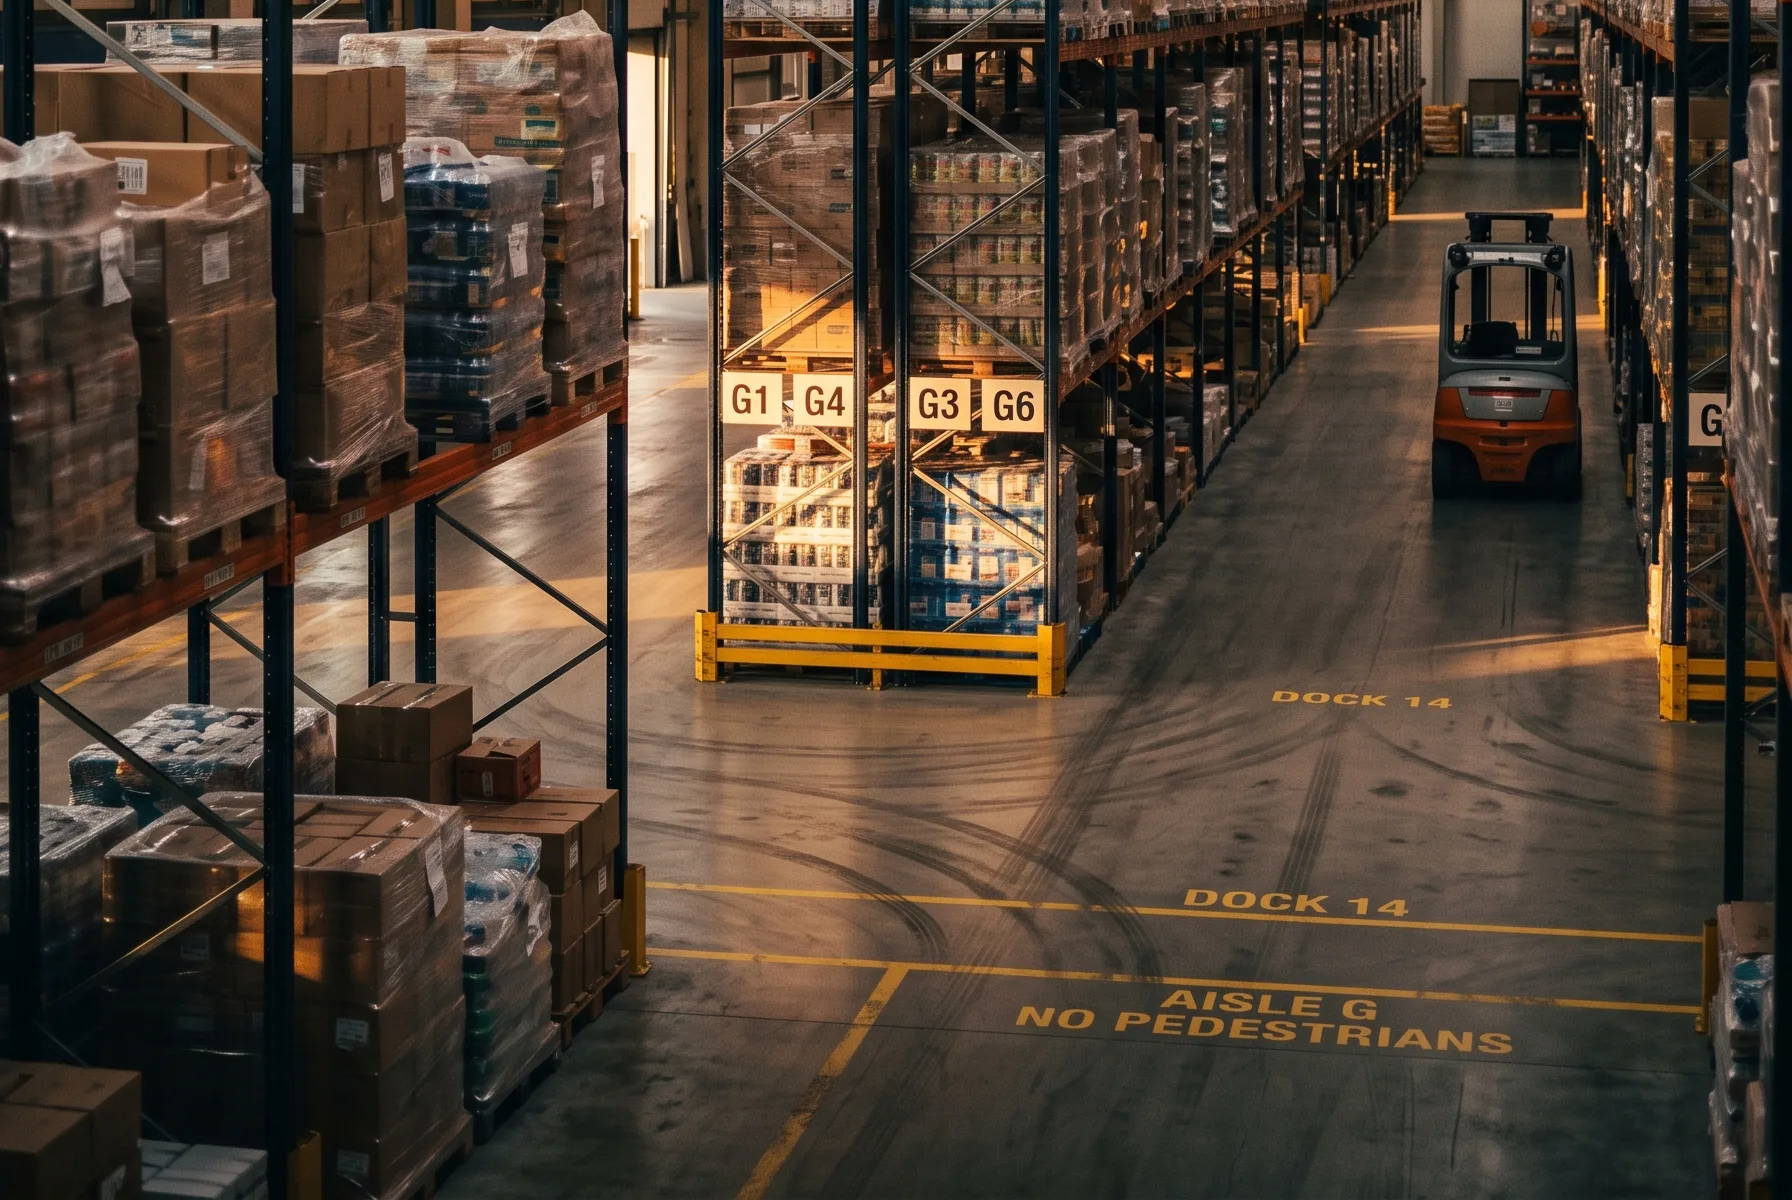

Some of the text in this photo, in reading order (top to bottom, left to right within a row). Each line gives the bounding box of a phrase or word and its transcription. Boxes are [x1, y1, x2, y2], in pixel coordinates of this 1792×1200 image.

[732, 383, 768, 415] G1
[804, 385, 846, 417] G4
[918, 388, 960, 420] G3
[993, 389, 1036, 422] G6
[1701, 403, 1723, 437] G
[1271, 690, 1453, 709] DOCK 14
[1183, 888, 1409, 917] DOCK 14
[1160, 989, 1378, 1021] AISLE G
[1014, 1005, 1514, 1055] NO PEDESTRIANS
